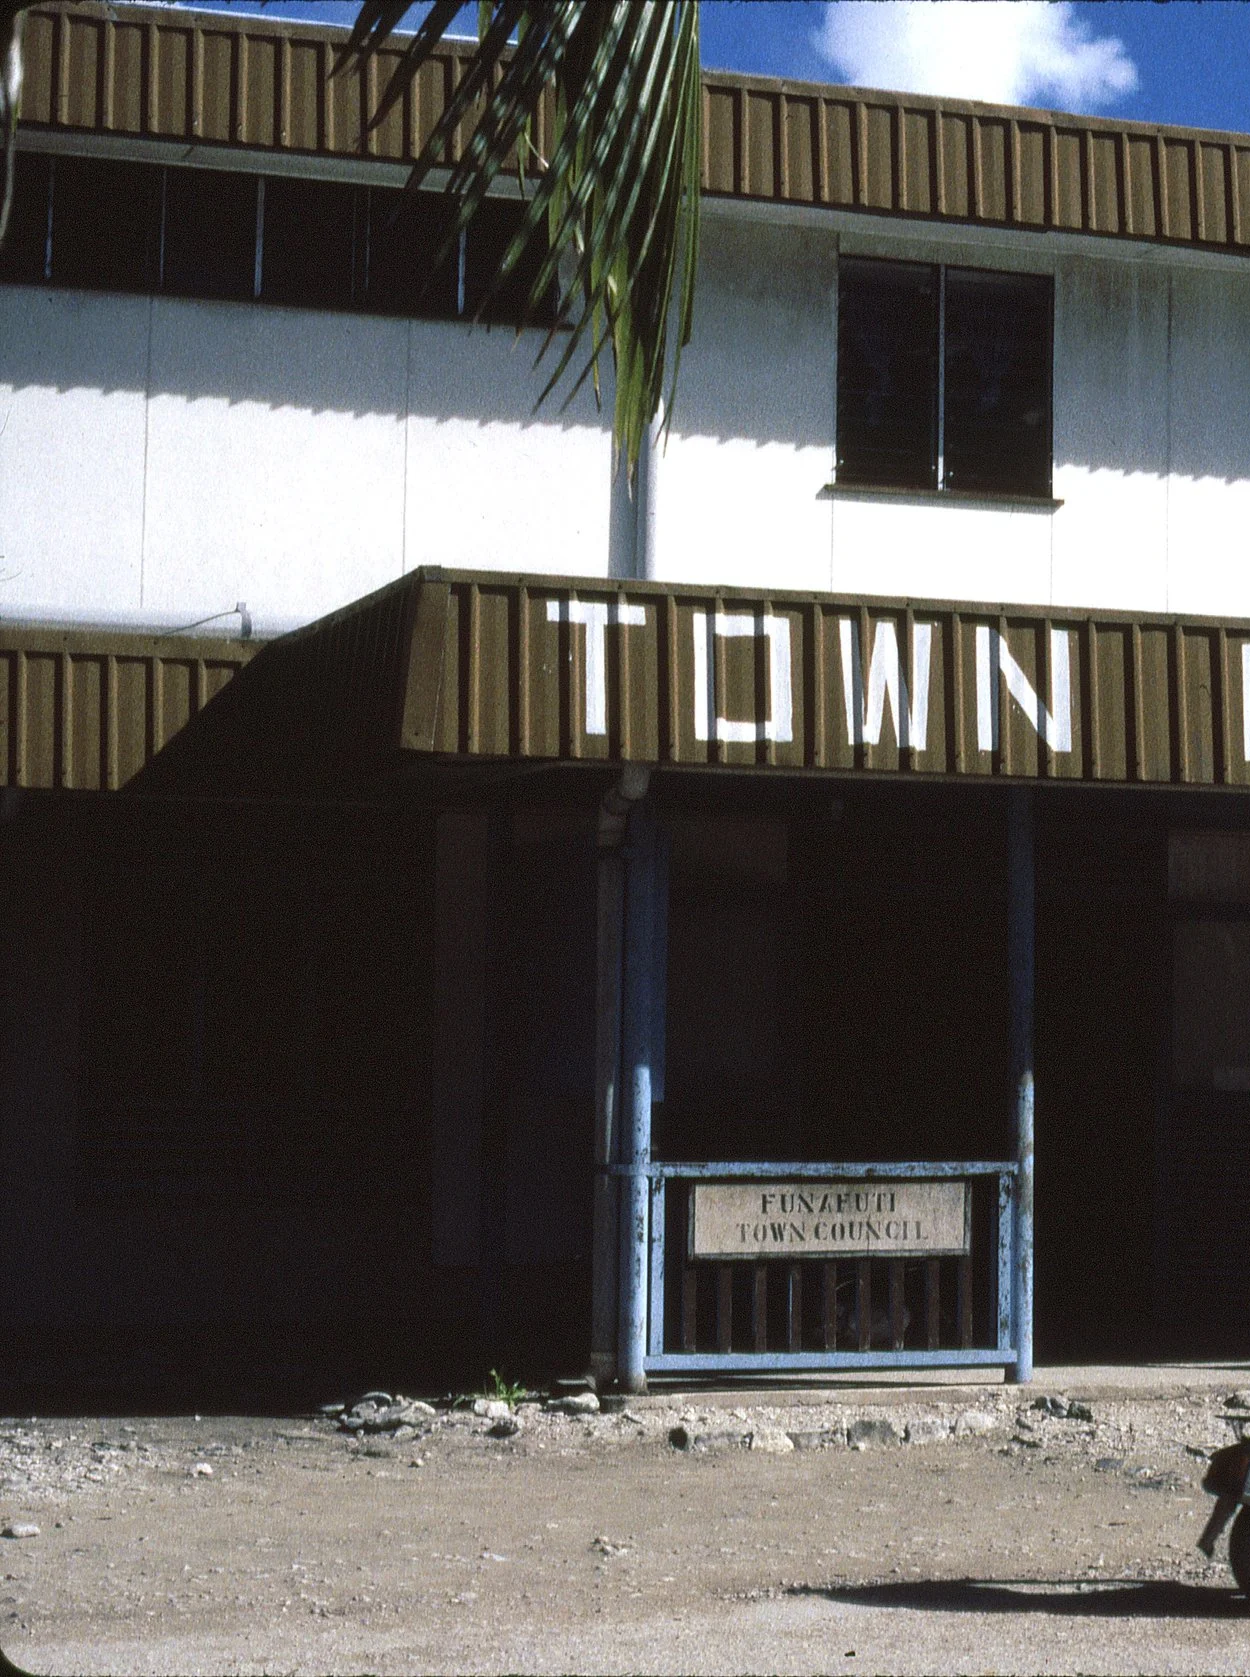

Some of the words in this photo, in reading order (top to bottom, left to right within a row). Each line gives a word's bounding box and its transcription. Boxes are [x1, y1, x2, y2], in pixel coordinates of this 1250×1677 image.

[546, 600, 1072, 752] TOWN
[760, 1191, 896, 1215] FUNAFUTI
[736, 1221, 806, 1244] TOWN
[813, 1219, 929, 1243] COUNCIL
